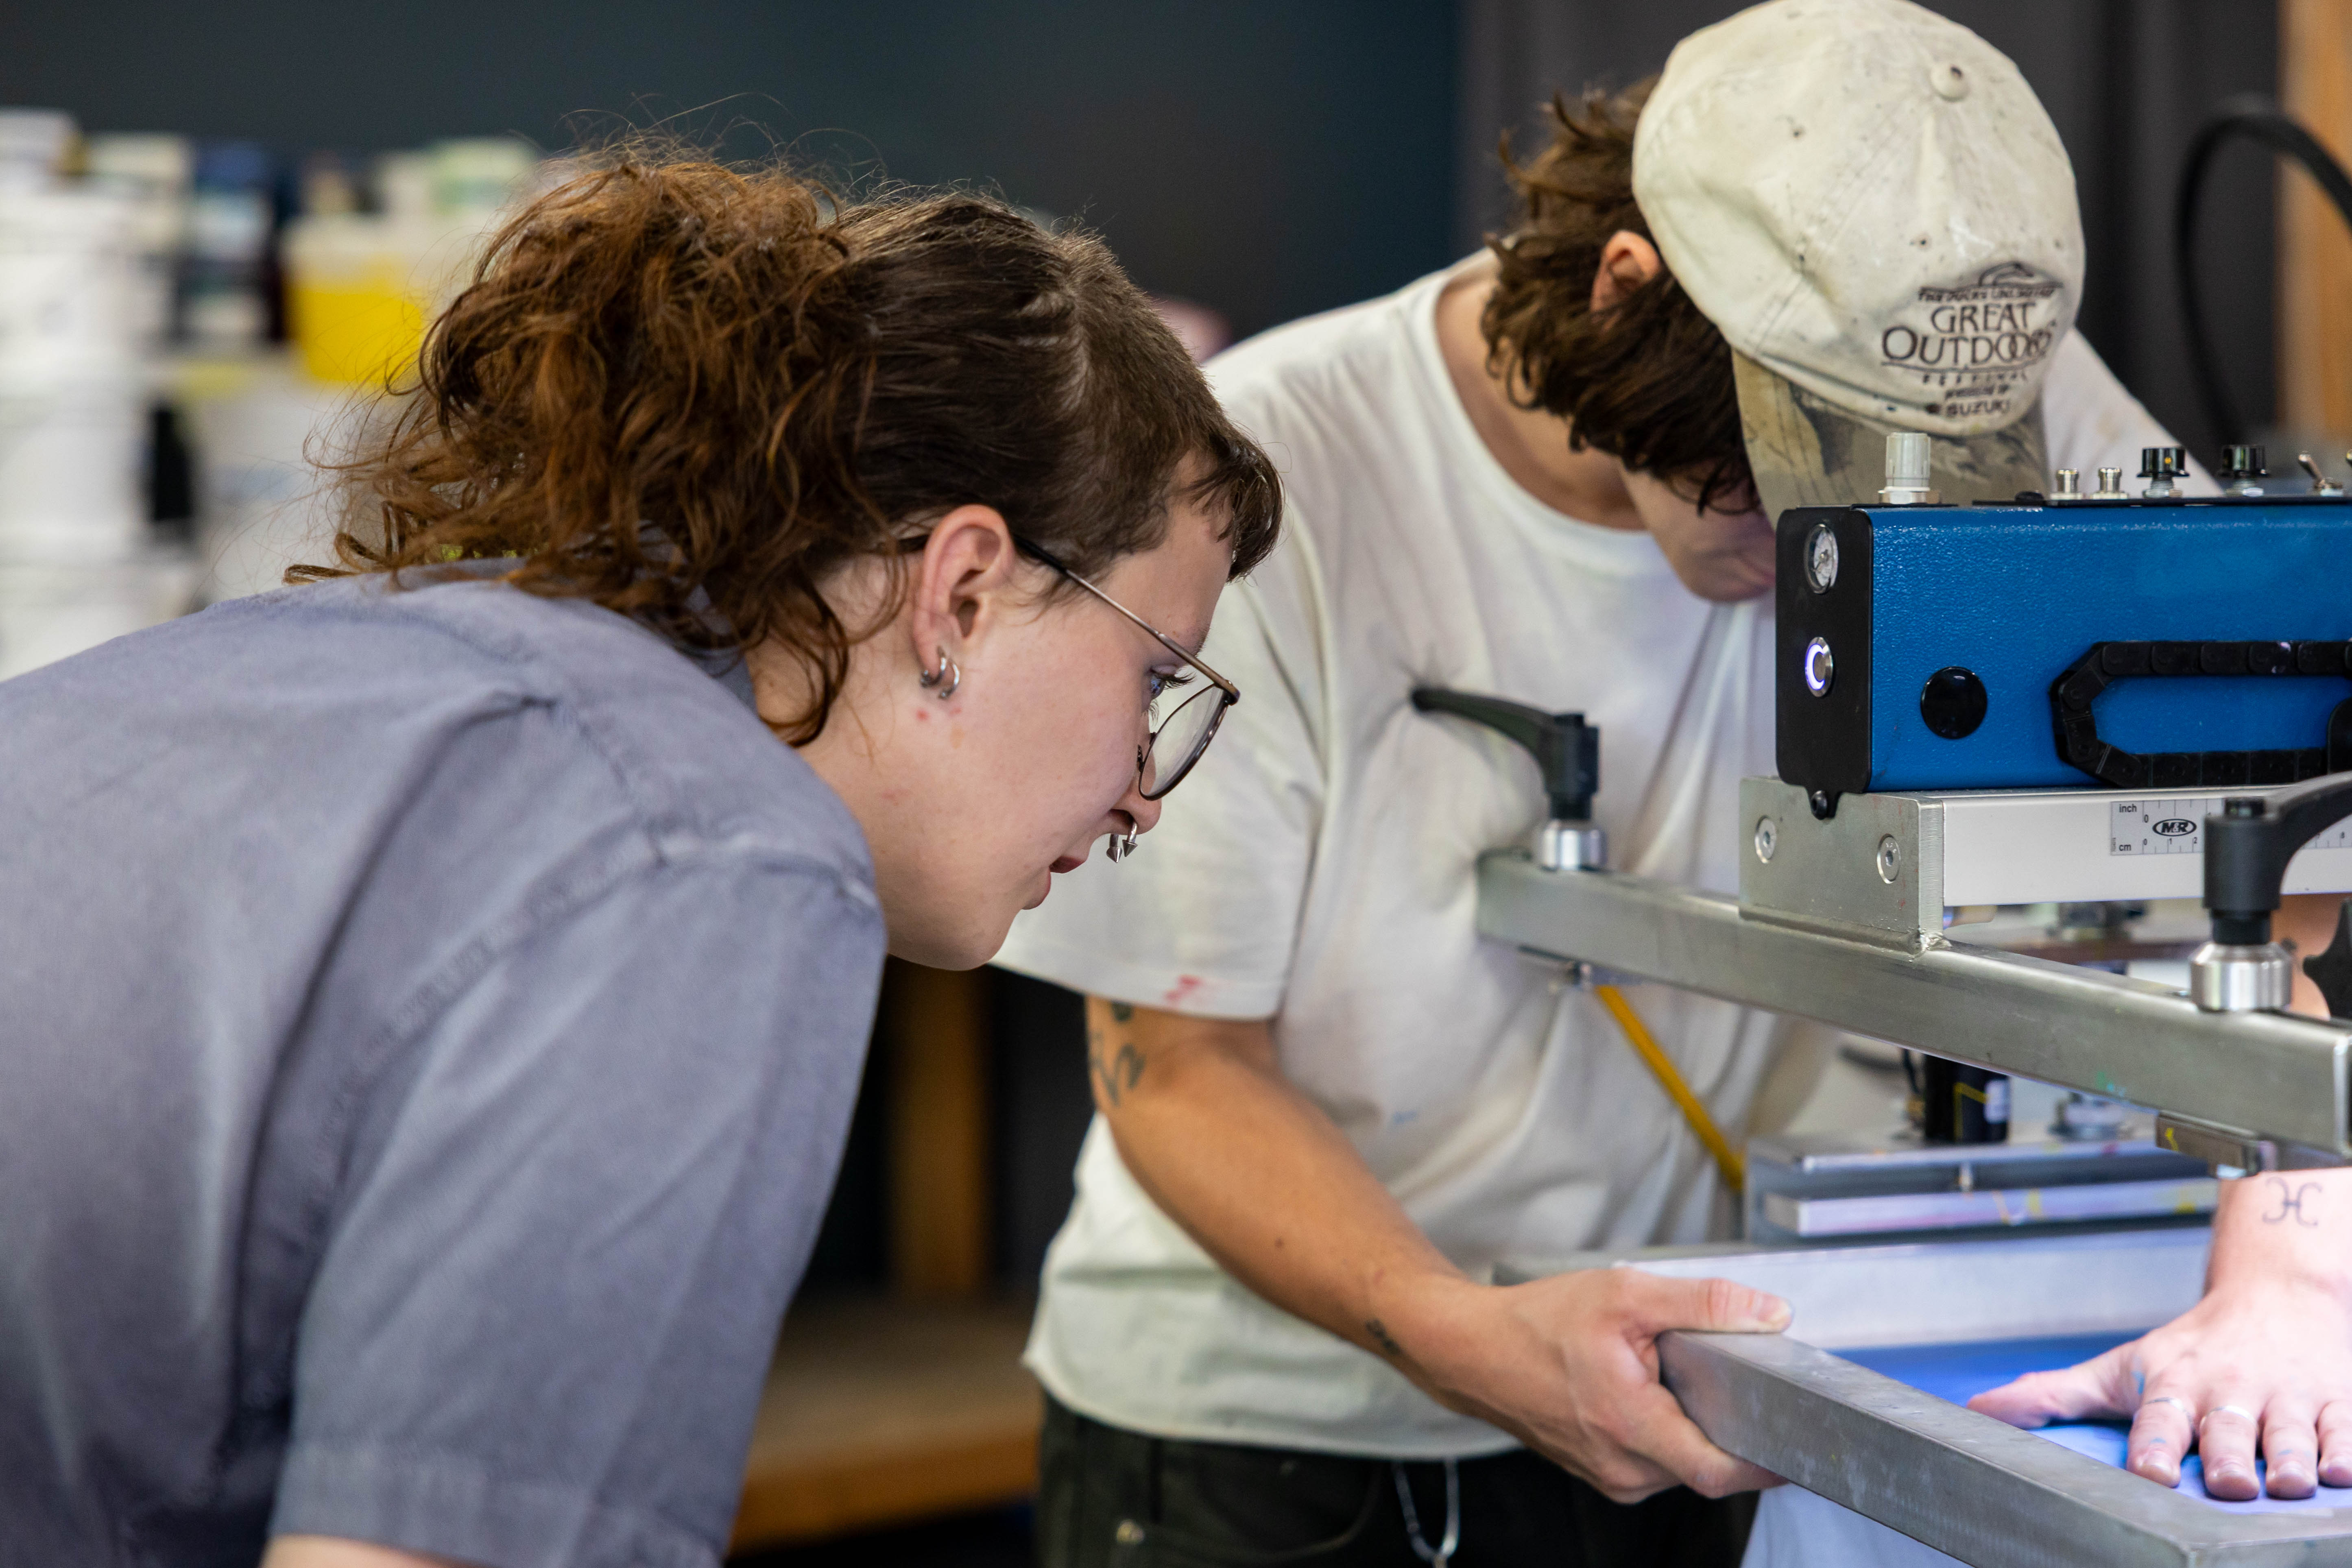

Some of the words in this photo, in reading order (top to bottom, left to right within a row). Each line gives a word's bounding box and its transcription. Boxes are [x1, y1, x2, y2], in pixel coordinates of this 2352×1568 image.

[1931, 303, 2036, 333] GREAT
[2119, 804, 2137, 813] inch
[2144, 814, 2149, 823] 0
[2161, 822, 2188, 833] M&R
